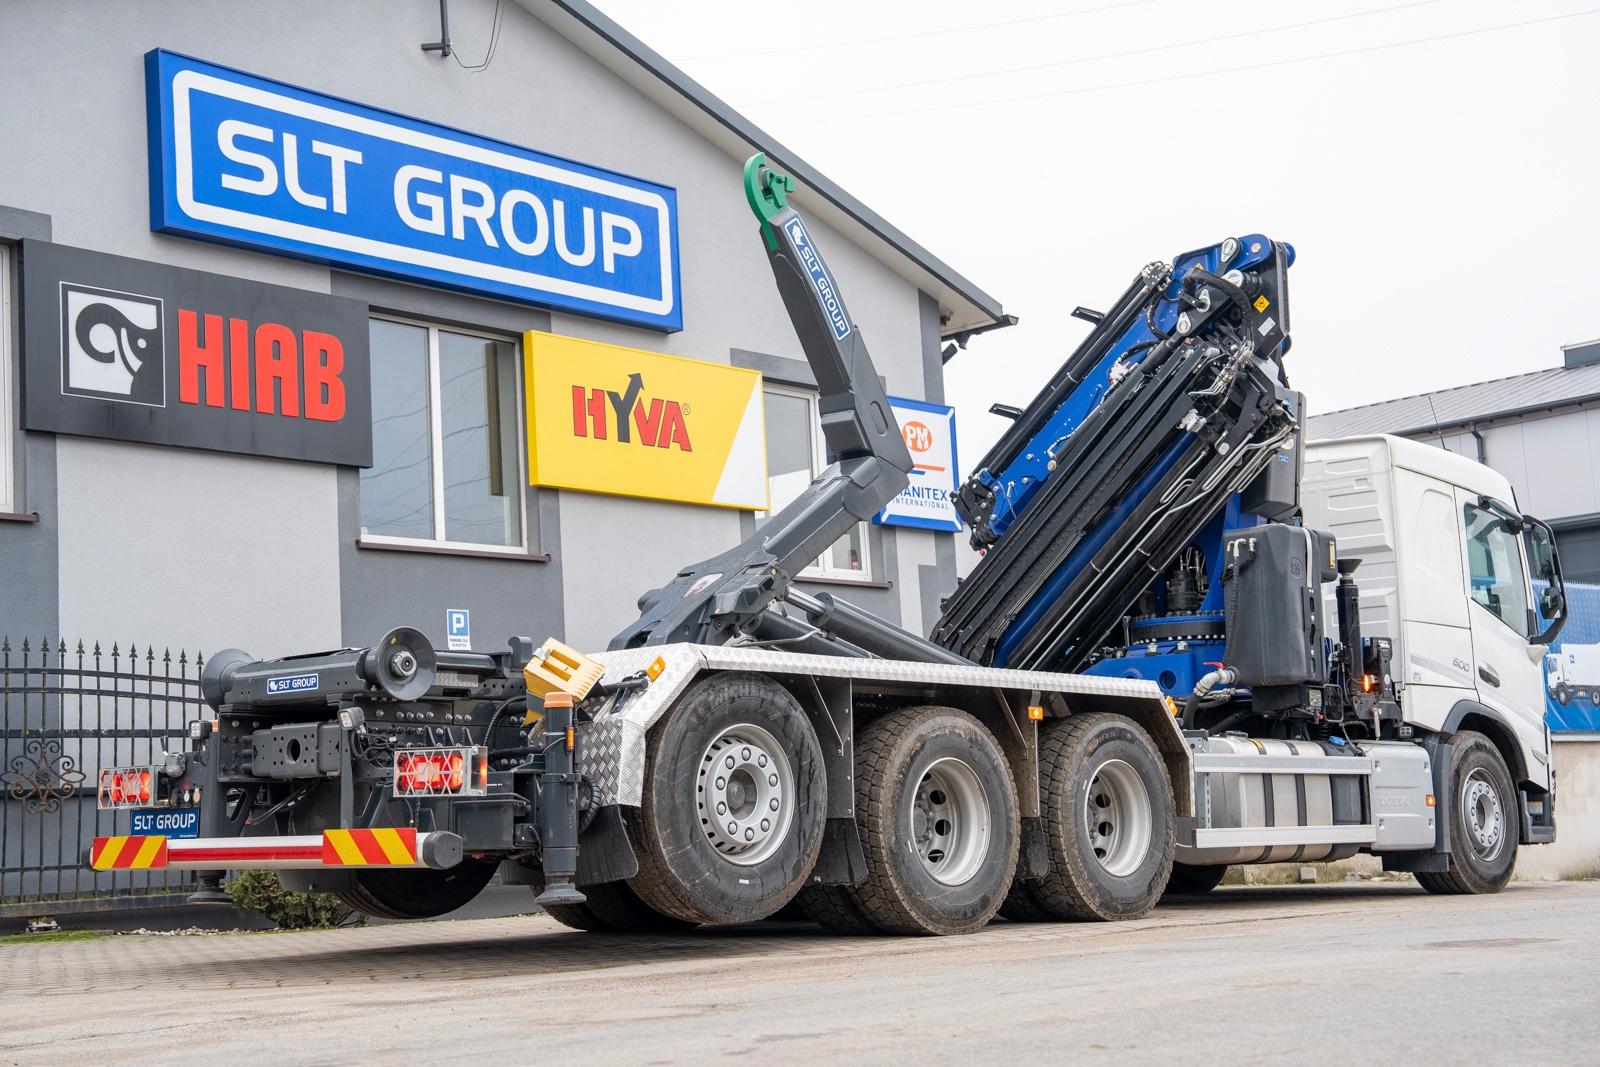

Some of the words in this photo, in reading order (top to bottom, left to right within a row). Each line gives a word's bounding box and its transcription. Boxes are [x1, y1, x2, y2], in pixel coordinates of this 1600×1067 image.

[217, 119, 363, 215] SLT
[393, 164, 643, 274] GROUP
[801, 246, 821, 273] SLT
[817, 277, 846, 332] GROUP
[178, 308, 346, 422] HIAB
[571, 372, 693, 453] HYVA
[905, 424, 930, 450] PM
[892, 497, 950, 510] INTERNATIONAL
[900, 486, 948, 502] ANITEX
[452, 613, 465, 634] P
[1452, 657, 1471, 673] 500
[278, 680, 291, 690] SLT
[291, 677, 317, 688] GROUP
[134, 815, 154, 830] SLT
[156, 813, 196, 829] GROUP
